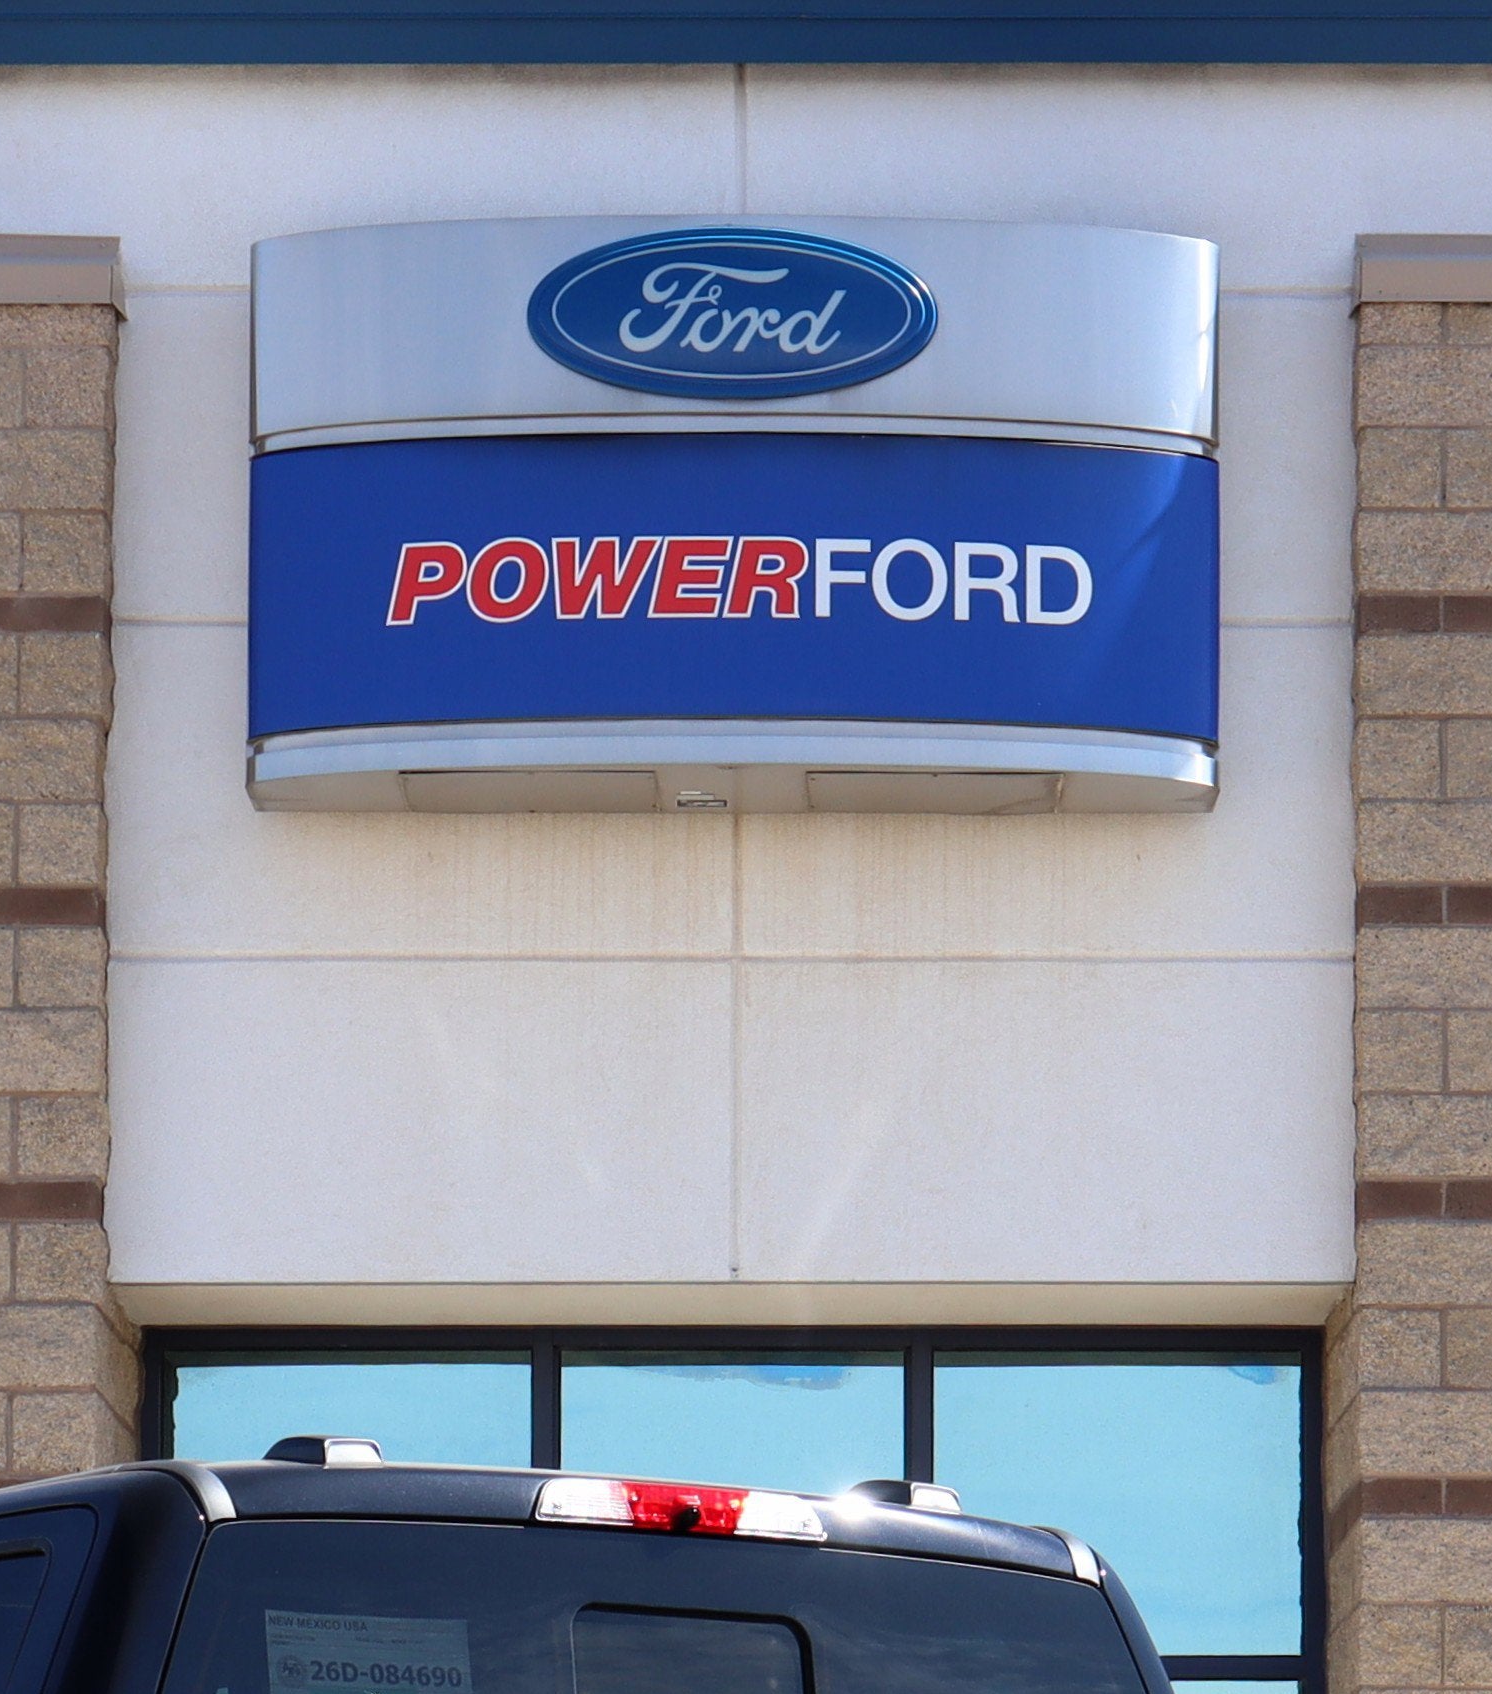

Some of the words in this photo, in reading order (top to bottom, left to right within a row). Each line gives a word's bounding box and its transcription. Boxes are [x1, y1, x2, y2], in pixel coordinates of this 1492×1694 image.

[618, 261, 848, 355] Ford
[385, 536, 1094, 627] POWERFORD
[268, 1615, 293, 1627] NEW
[297, 1617, 340, 1631] MEXICO
[344, 1620, 369, 1632] USA
[310, 1660, 463, 1688] 26D-084690
